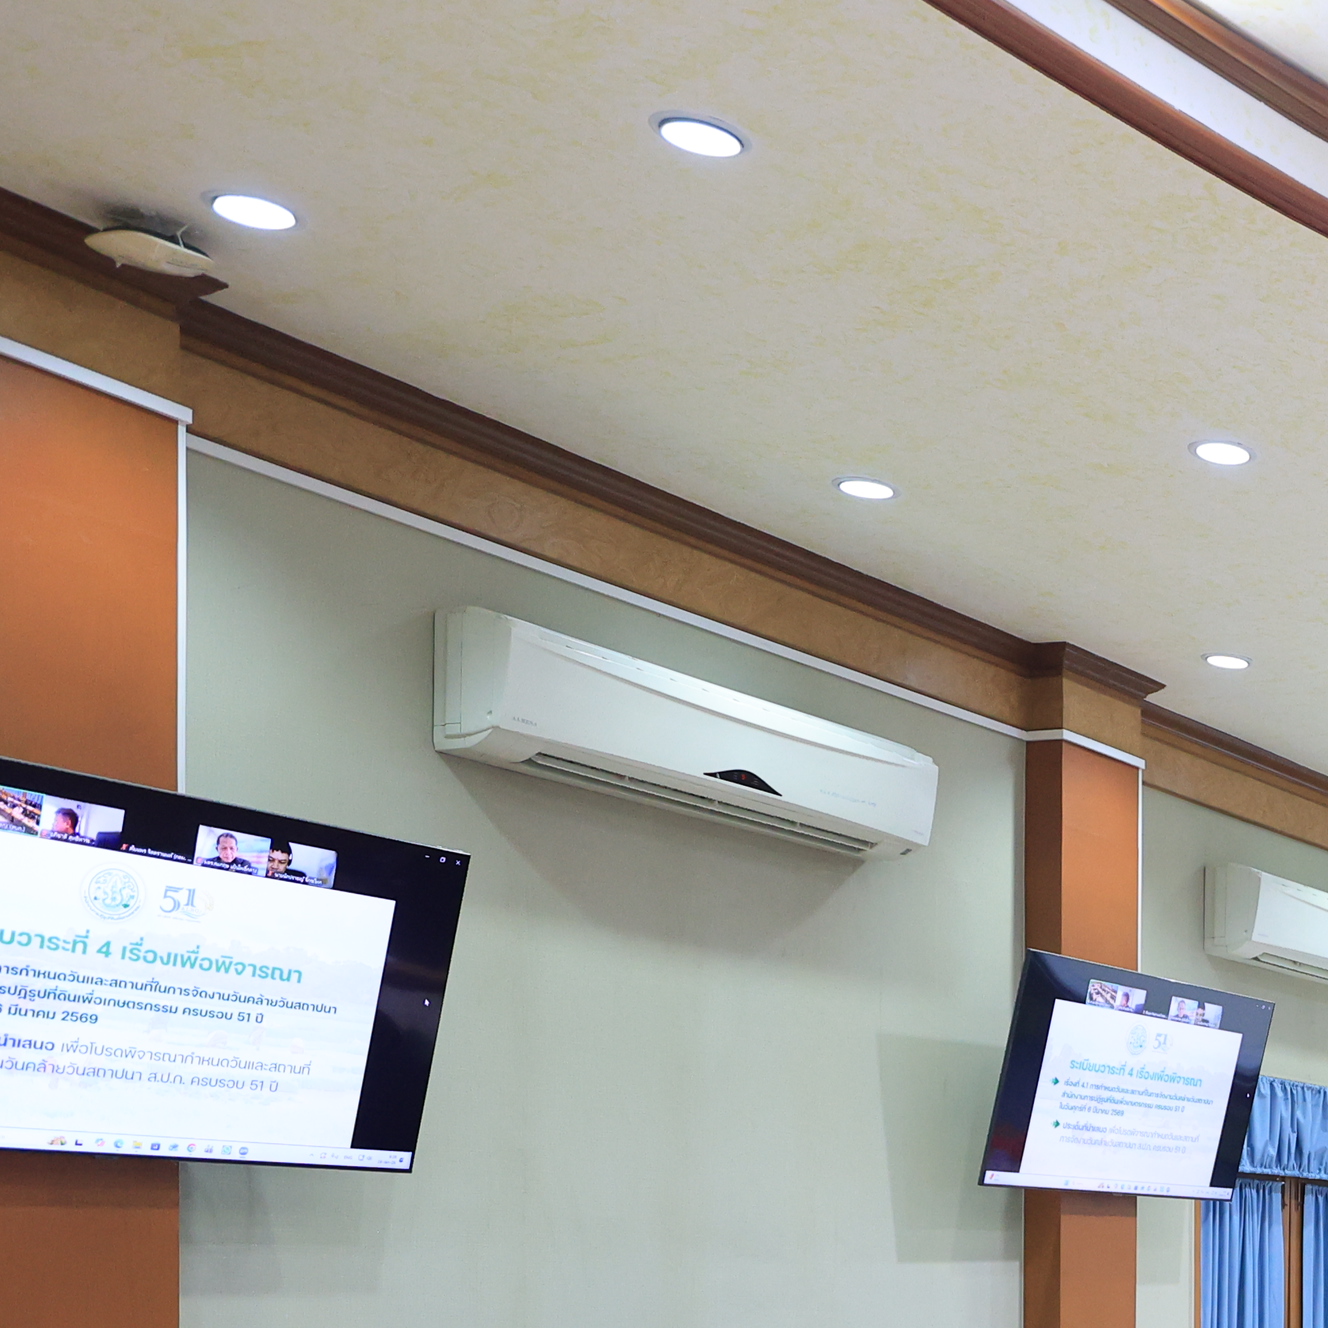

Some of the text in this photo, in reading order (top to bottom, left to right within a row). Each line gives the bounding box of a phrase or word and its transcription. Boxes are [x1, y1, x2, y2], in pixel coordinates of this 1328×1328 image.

[96, 940, 112, 958] 4
[121, 937, 303, 984] เรื่องเพื่อพิจารณา
[8, 1005, 98, 1024] มีนาคม 2569
[182, 1006, 233, 1021] ครบรอบ
[237, 1012, 251, 1022] 51
[255, 1012, 264, 1024] ปี
[61, 1038, 312, 1076] เพื่อโปรดพิจารณากำหนดวันและสถานที่
[148, 1071, 185, 1085] ส.ป.ก.
[191, 1075, 245, 1090] ครบรอบ
[250, 1080, 264, 1092] 51
[269, 1080, 278, 1093] ปี
[1128, 1067, 1134, 1077] 4
